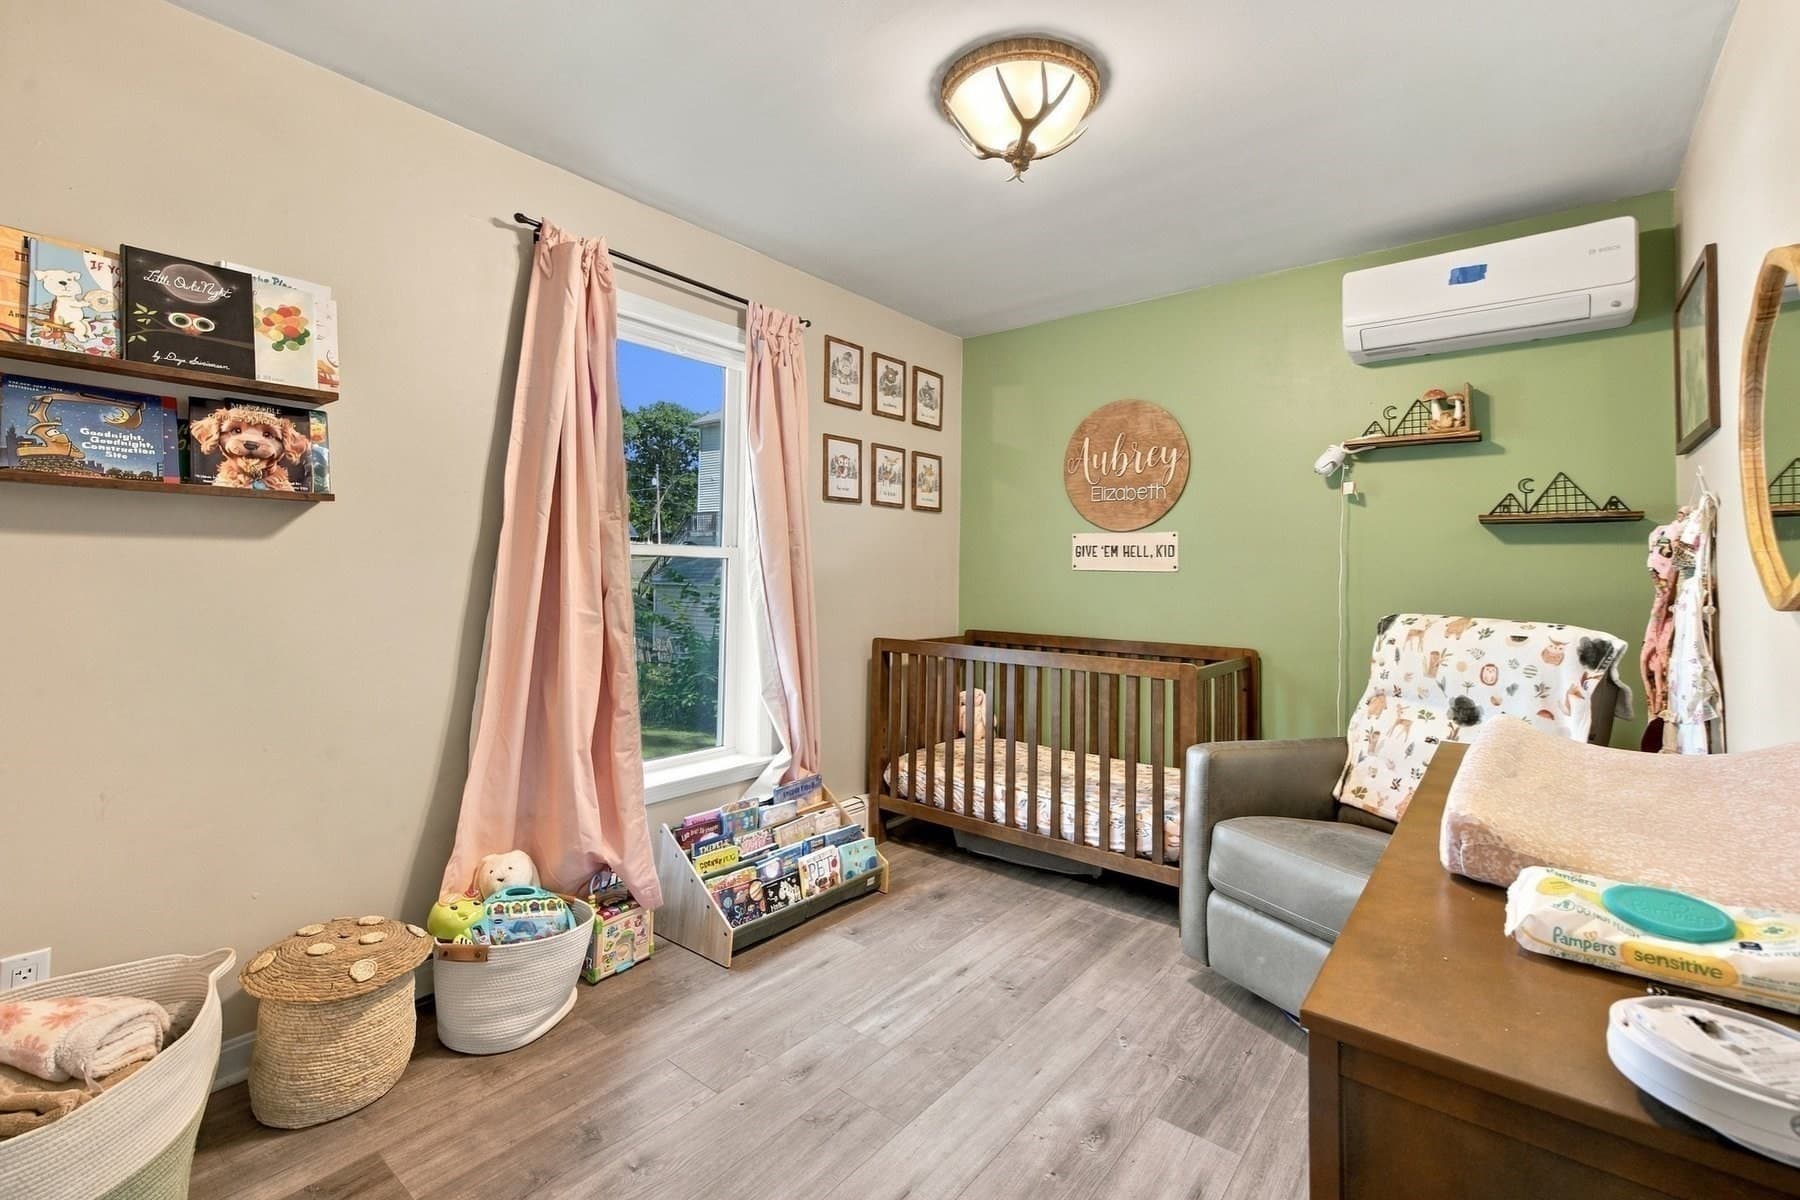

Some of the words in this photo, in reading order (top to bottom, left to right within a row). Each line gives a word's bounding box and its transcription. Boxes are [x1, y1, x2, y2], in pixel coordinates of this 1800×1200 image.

[89, 260, 105, 271] IF
[108, 264, 121, 276] YO
[143, 269, 171, 287] Little
[200, 282, 232, 301] Night
[79, 427, 145, 442] Goodnight,
[81, 441, 156, 456] Construction
[89, 436, 155, 450] Goodnight,
[104, 450, 129, 460] Site
[1067, 431, 1184, 486] Aubrey
[1091, 483, 1167, 502] Elizabeth
[1075, 545, 1098, 558] GIVE
[1100, 545, 1119, 558] 'EM
[1123, 545, 1154, 559] HELL,
[1155, 544, 1175, 558] KID
[1552, 926, 1617, 957] Pampers
[1633, 949, 1724, 981] sensitive
